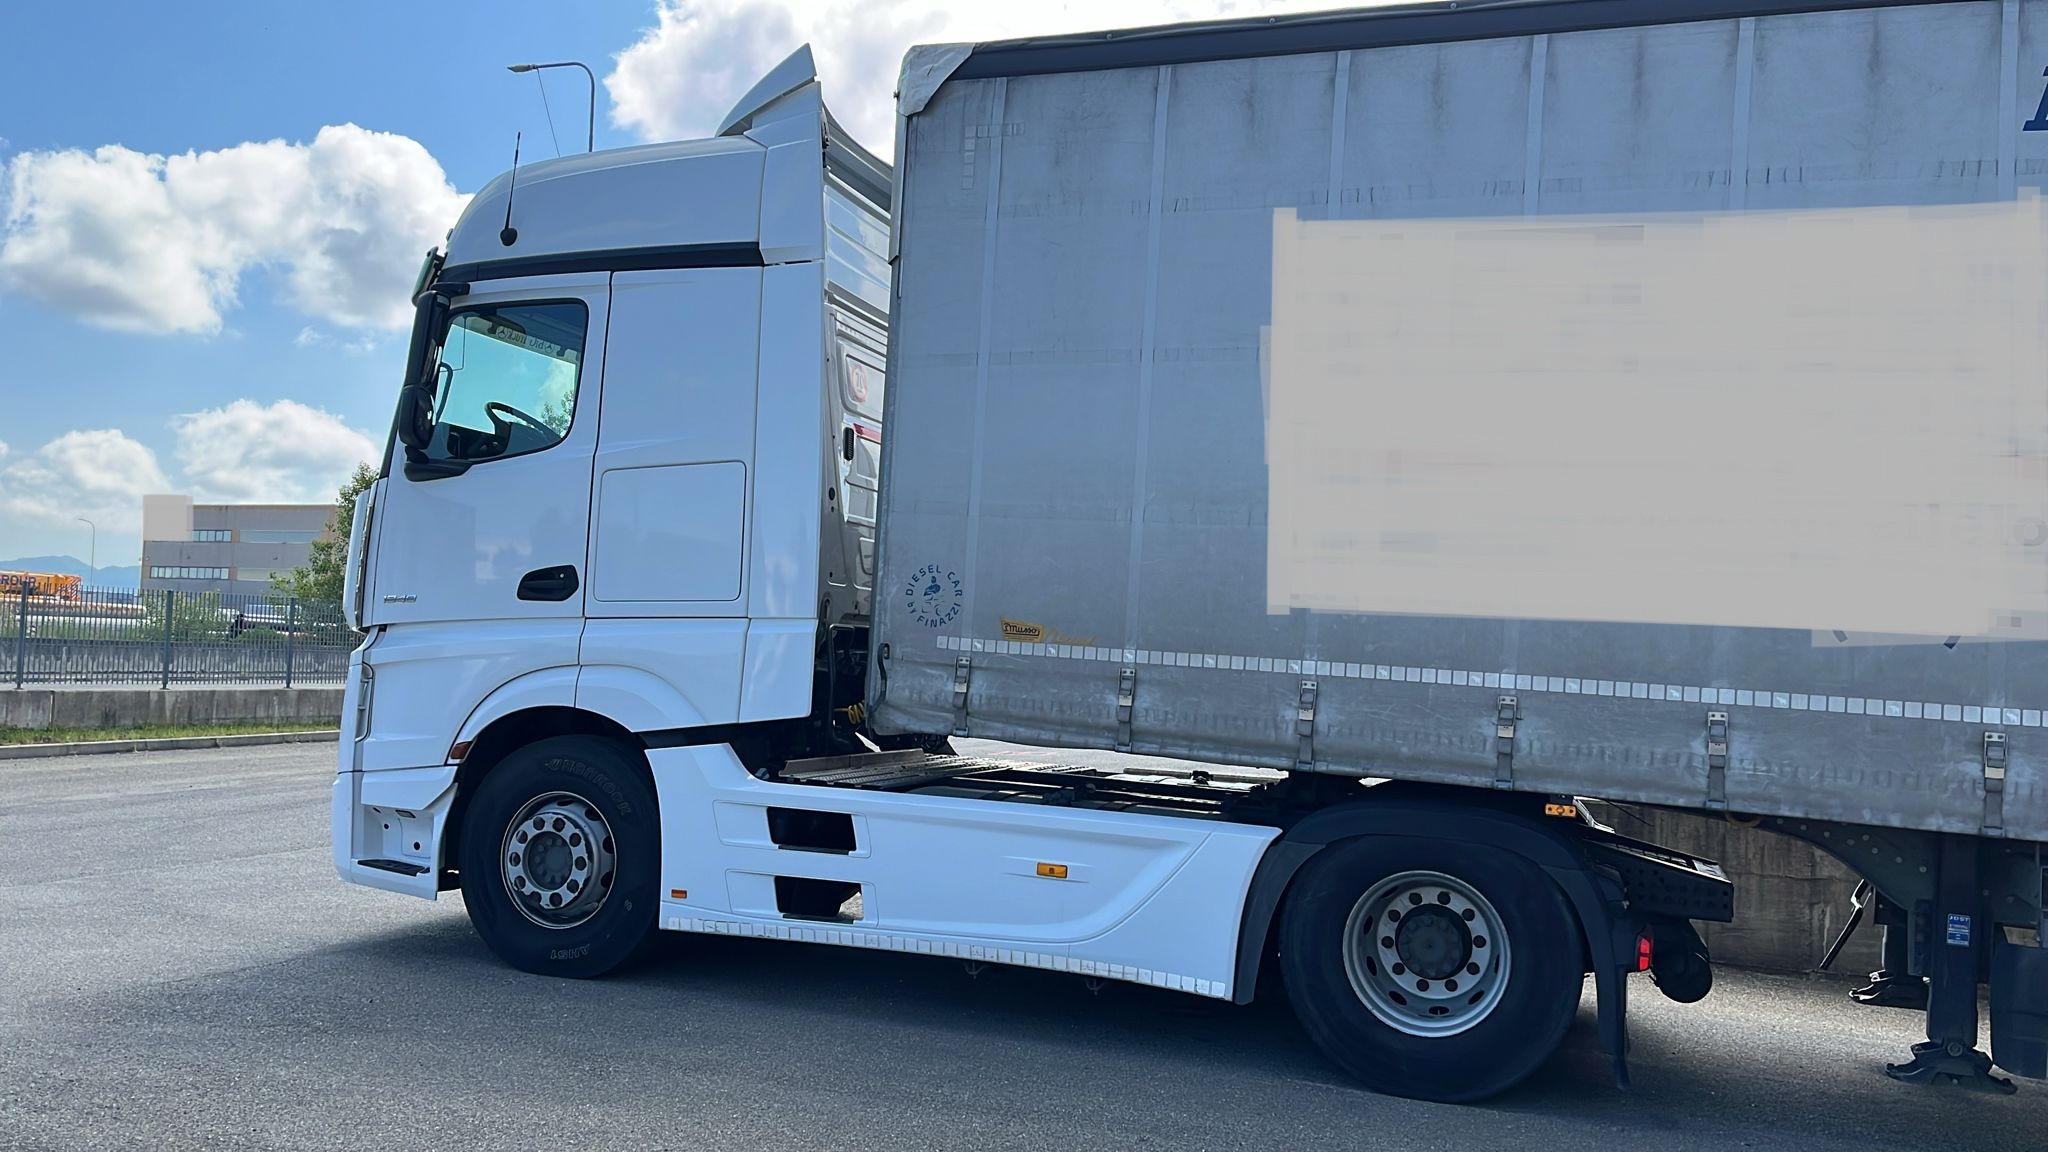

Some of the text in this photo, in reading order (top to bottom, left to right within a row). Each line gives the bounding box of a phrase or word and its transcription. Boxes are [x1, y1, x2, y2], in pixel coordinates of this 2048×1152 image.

[0, 575, 36, 587] ROUP
[905, 564, 963, 597] DIESEL CAR
[917, 603, 961, 628] FINAZZI
